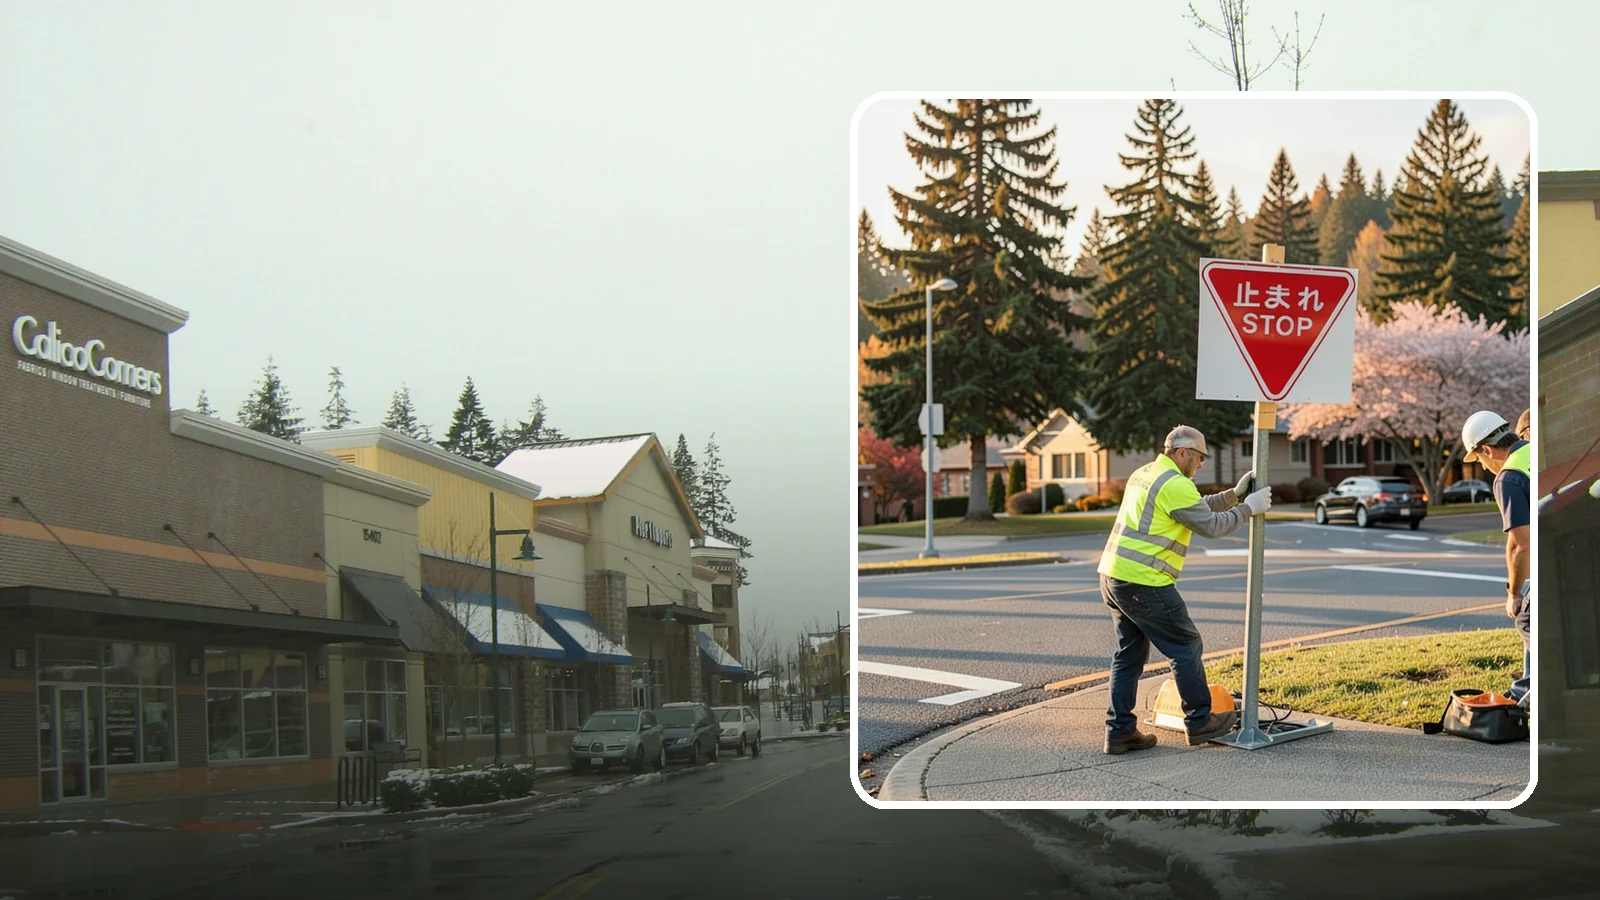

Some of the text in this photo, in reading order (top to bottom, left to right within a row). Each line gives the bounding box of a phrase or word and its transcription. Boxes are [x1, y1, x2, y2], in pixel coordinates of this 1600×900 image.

[1233, 281, 1324, 312] 止まれ
[1242, 313, 1313, 337] STOP
[17, 360, 47, 377] FABRICS
[51, 371, 78, 386] WINDOW
[79, 378, 116, 399] TREATMENTS
